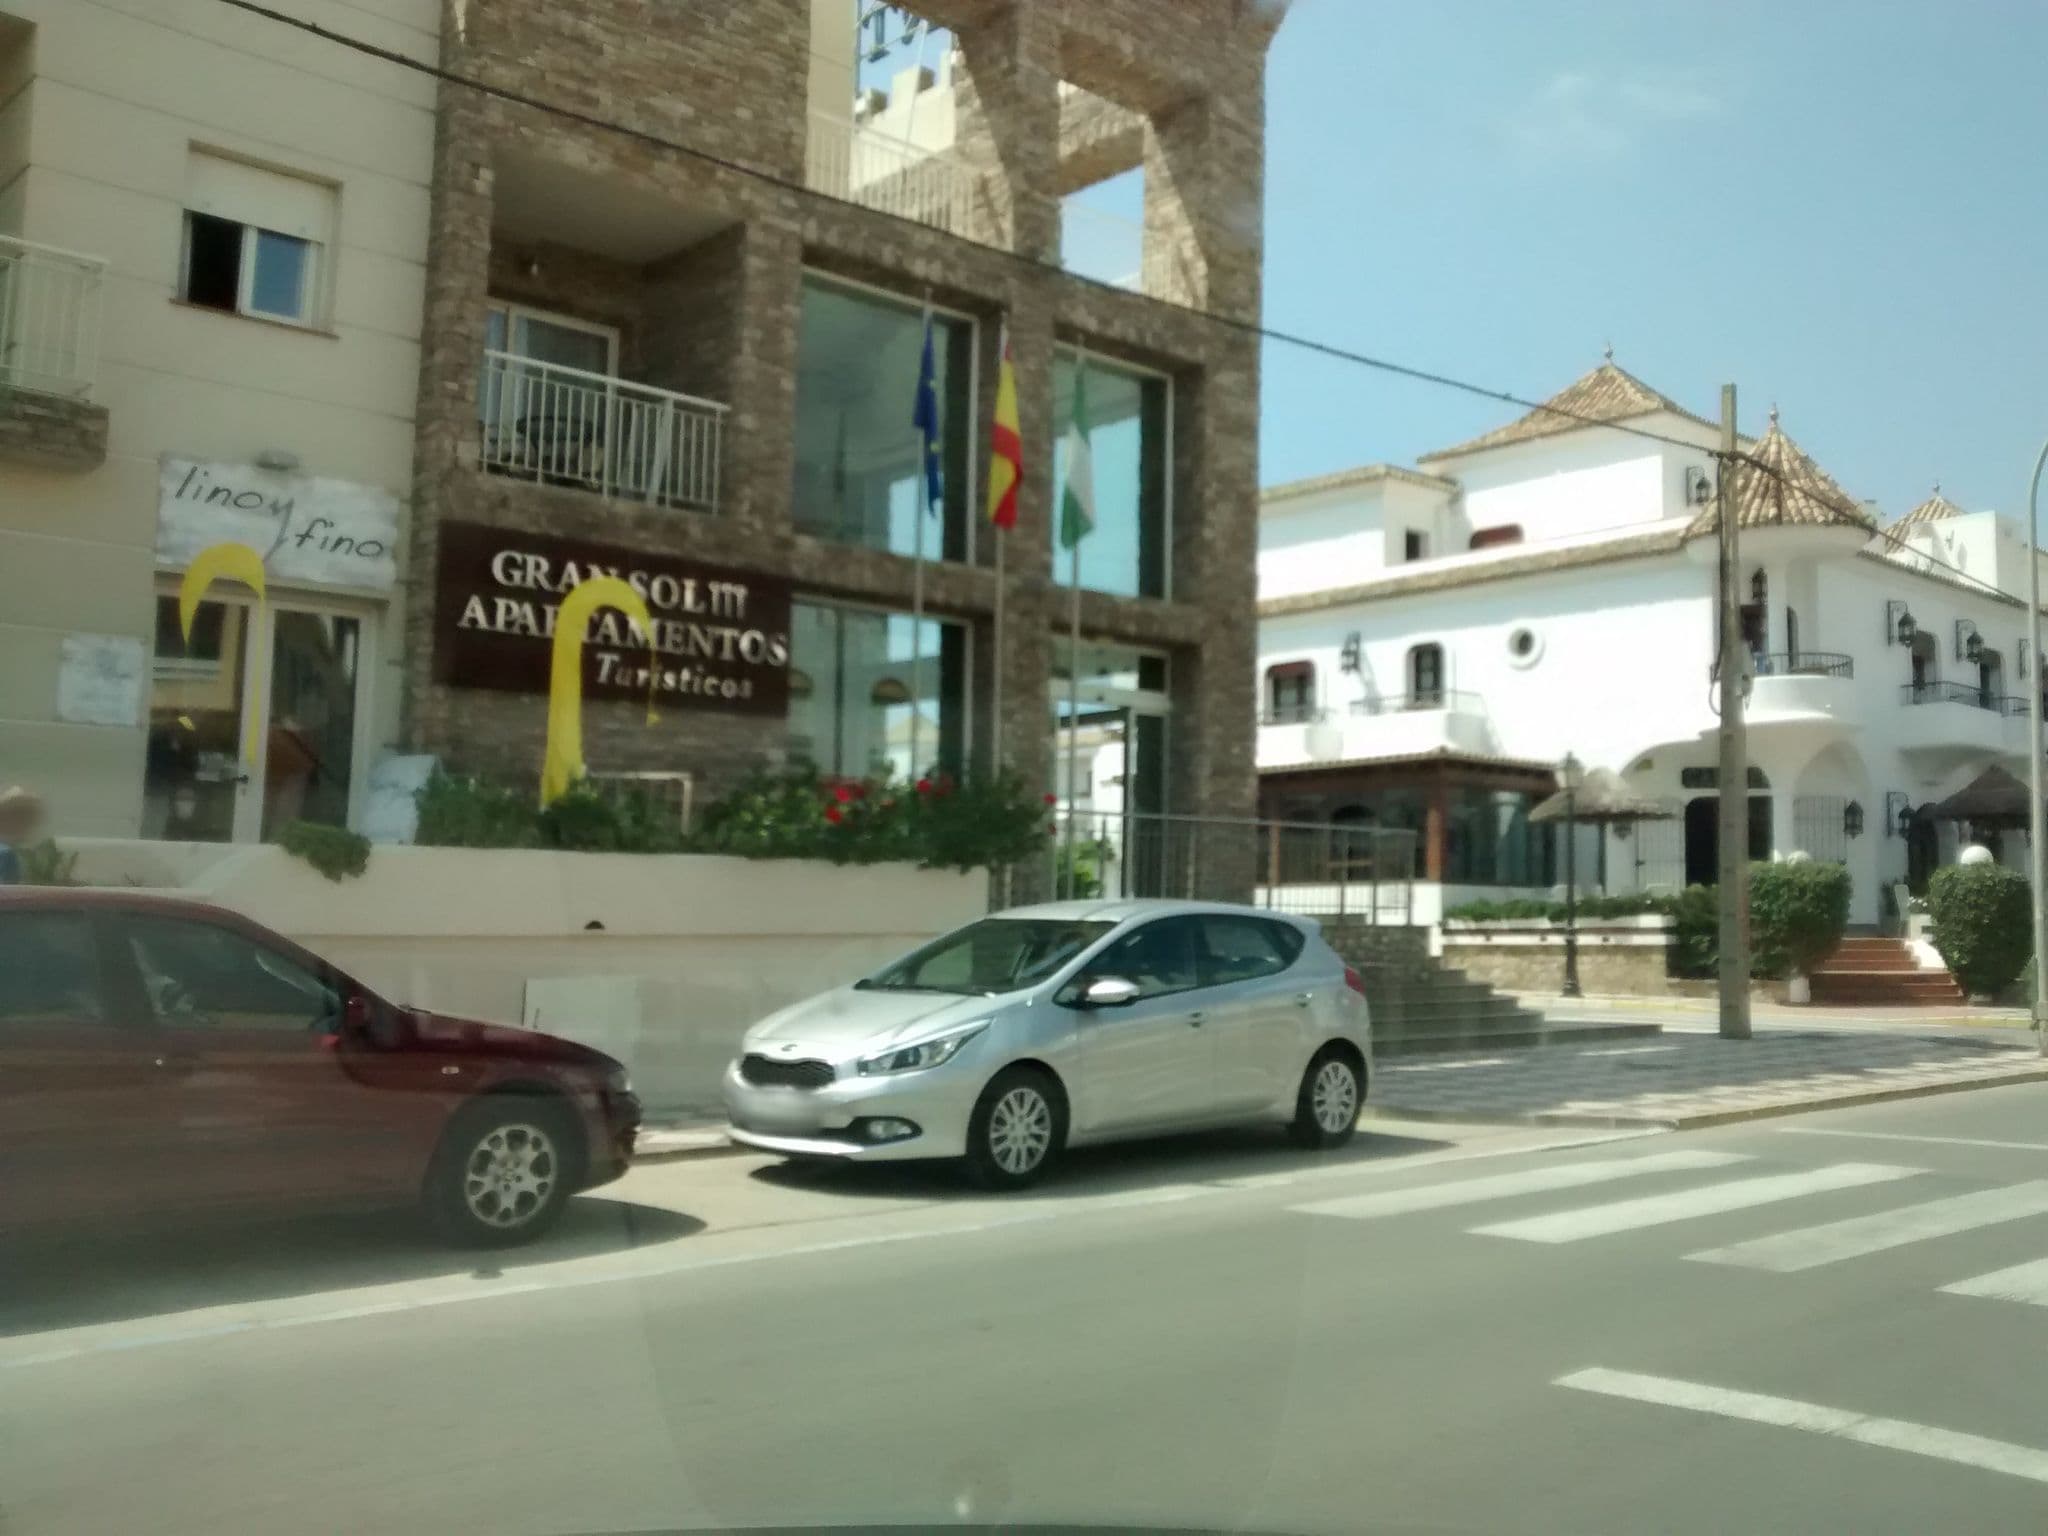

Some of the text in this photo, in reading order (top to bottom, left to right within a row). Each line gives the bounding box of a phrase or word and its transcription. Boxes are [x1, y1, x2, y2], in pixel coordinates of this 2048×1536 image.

[174, 465, 384, 561] lino y fino
